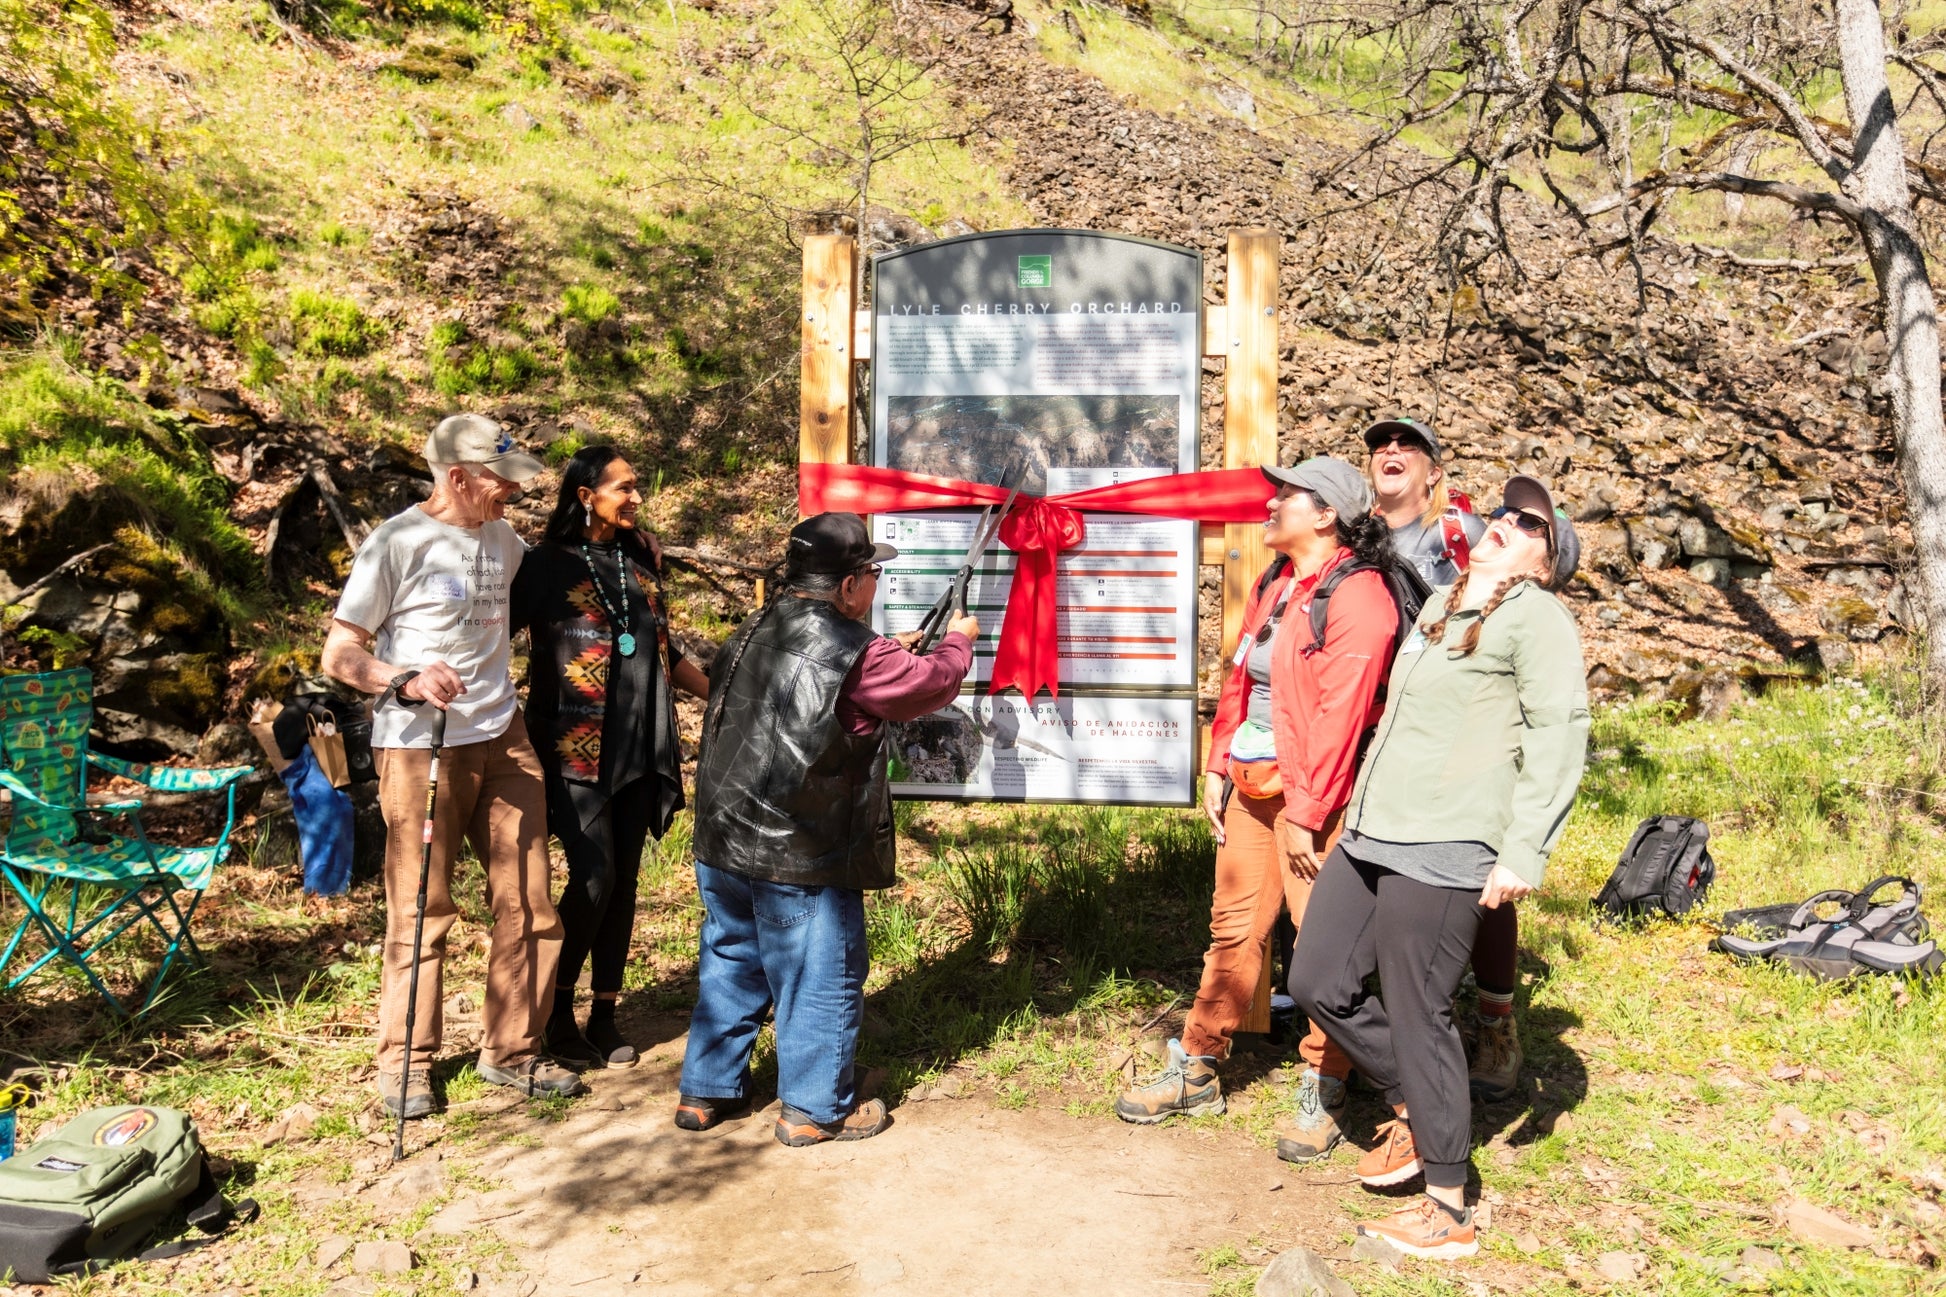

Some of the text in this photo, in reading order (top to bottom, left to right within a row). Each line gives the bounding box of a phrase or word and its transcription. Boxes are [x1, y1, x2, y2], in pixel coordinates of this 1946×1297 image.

[890, 302, 1182, 316] LYLE CHERRY ORCHARD
[473, 596, 480, 606] in
[481, 598, 492, 609] my
[457, 616, 473, 626] I'm
[474, 618, 480, 626] a
[998, 706, 1061, 714] ADVISORY
[1041, 719, 1079, 727] AVISO
[1107, 719, 1179, 729] ANIDACIÓN
[1090, 729, 1179, 738] DE HALCONES
